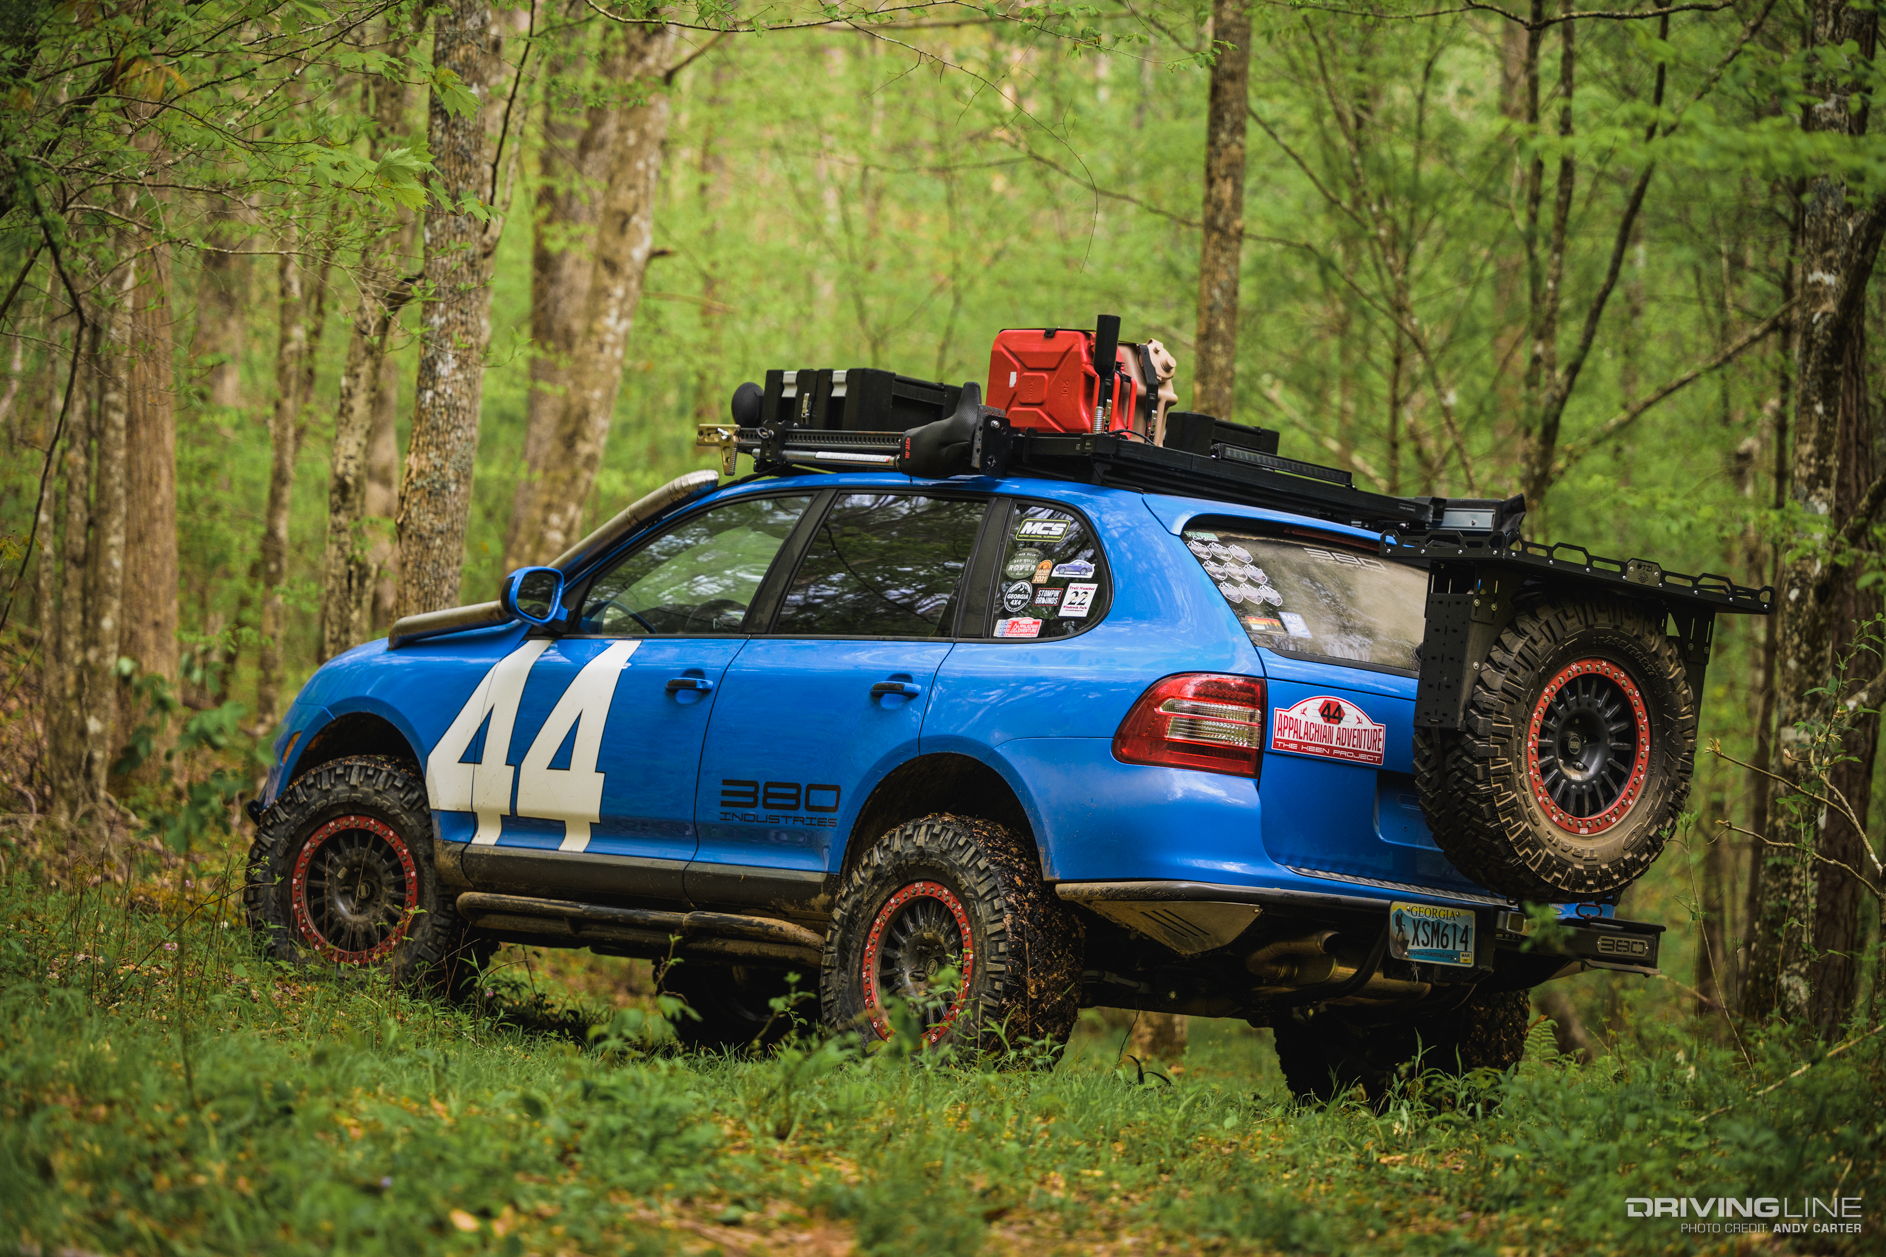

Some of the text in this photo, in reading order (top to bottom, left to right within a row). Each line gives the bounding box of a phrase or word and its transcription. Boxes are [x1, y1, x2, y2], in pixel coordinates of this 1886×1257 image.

[1019, 521, 1067, 536] MCS
[1007, 564, 1036, 572] ROVER
[1303, 547, 1387, 571] 380
[1067, 590, 1089, 606] 22
[1320, 702, 1344, 724] 44
[1276, 713, 1383, 752] APPALACHIAN ADVENTURE
[425, 639, 643, 853] 44
[1275, 741, 1381, 762] THE KEEN PROJECT
[720, 779, 842, 813] 380
[720, 812, 838, 827] INDUSTRIES
[1410, 906, 1457, 921] GEORGIA
[1411, 919, 1469, 951] XSM614
[1600, 938, 1646, 955] 380
